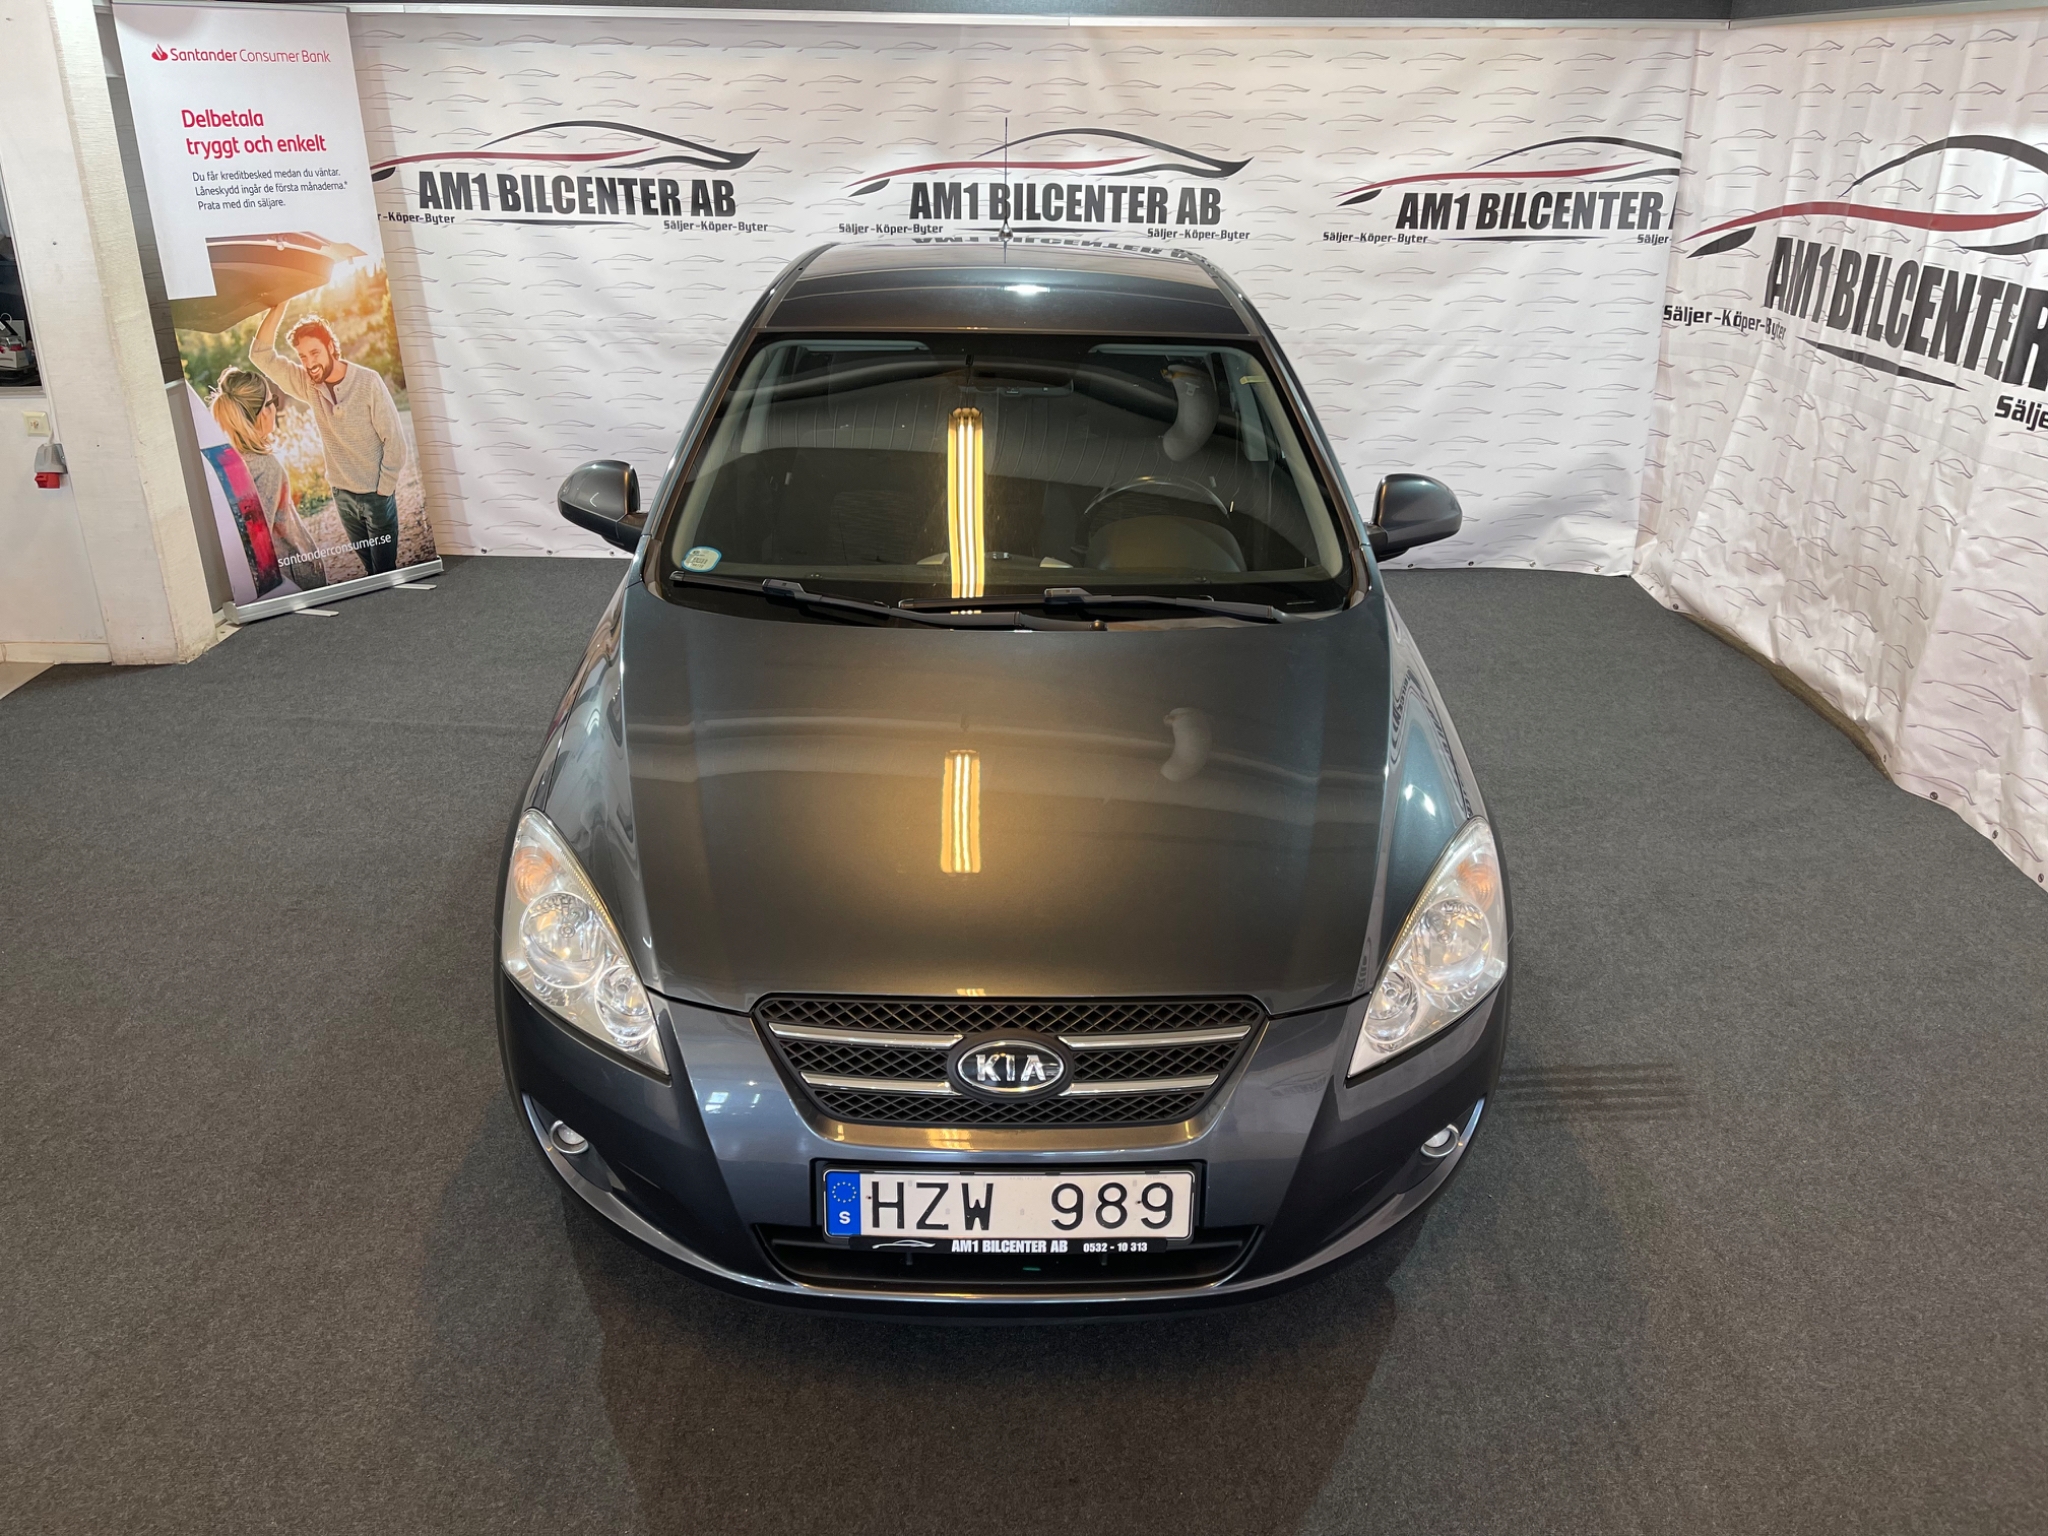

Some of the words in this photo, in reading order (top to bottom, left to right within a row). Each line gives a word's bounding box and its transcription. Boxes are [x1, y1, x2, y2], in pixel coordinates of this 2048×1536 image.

[170, 47, 237, 62] Santander
[239, 49, 300, 63] Consumer
[302, 49, 331, 63] Bank
[181, 108, 264, 128] Delbetala
[186, 136, 240, 160] tryggt
[244, 134, 274, 154] och
[277, 134, 327, 152] enkelt
[192, 171, 205, 182] Du
[206, 171, 219, 181] får
[220, 169, 273, 181] kreditbesked
[274, 168, 302, 179] medan
[303, 168, 314, 178] du
[315, 167, 341, 178] väntar.
[195, 184, 240, 197] Låneskydd
[241, 183, 262, 197] ingår
[263, 183, 275, 193] de
[275, 182, 300, 193] första
[419, 170, 491, 211] AM1
[496, 173, 682, 217] BILCENTER
[690, 178, 737, 218] AB
[198, 200, 221, 211] Prata
[222, 199, 242, 209] med
[243, 198, 256, 208] din
[257, 198, 287, 210] säljare.
[908, 181, 979, 220] AM1
[989, 182, 1169, 224] BILCENTER
[1175, 186, 1222, 226] AB
[1395, 192, 1470, 230] AM1
[1475, 191, 1664, 230] BILCENTER
[1764, 236, 1836, 324] AM1
[1826, 247, 2048, 392] BILCENTER
[277, 533, 392, 568] santanderconsumer.se
[975, 1053, 1047, 1083] KIA
[839, 1210, 851, 1225] S
[871, 1181, 994, 1231] HZW
[1051, 1182, 1175, 1231] 989
[951, 1239, 979, 1253] AM1
[982, 1239, 1047, 1253] BILCENTER
[1050, 1239, 1068, 1253] AB
[1083, 1242, 1107, 1253] 0532
[1117, 1242, 1128, 1252] 10
[1130, 1242, 1148, 1252] 313
